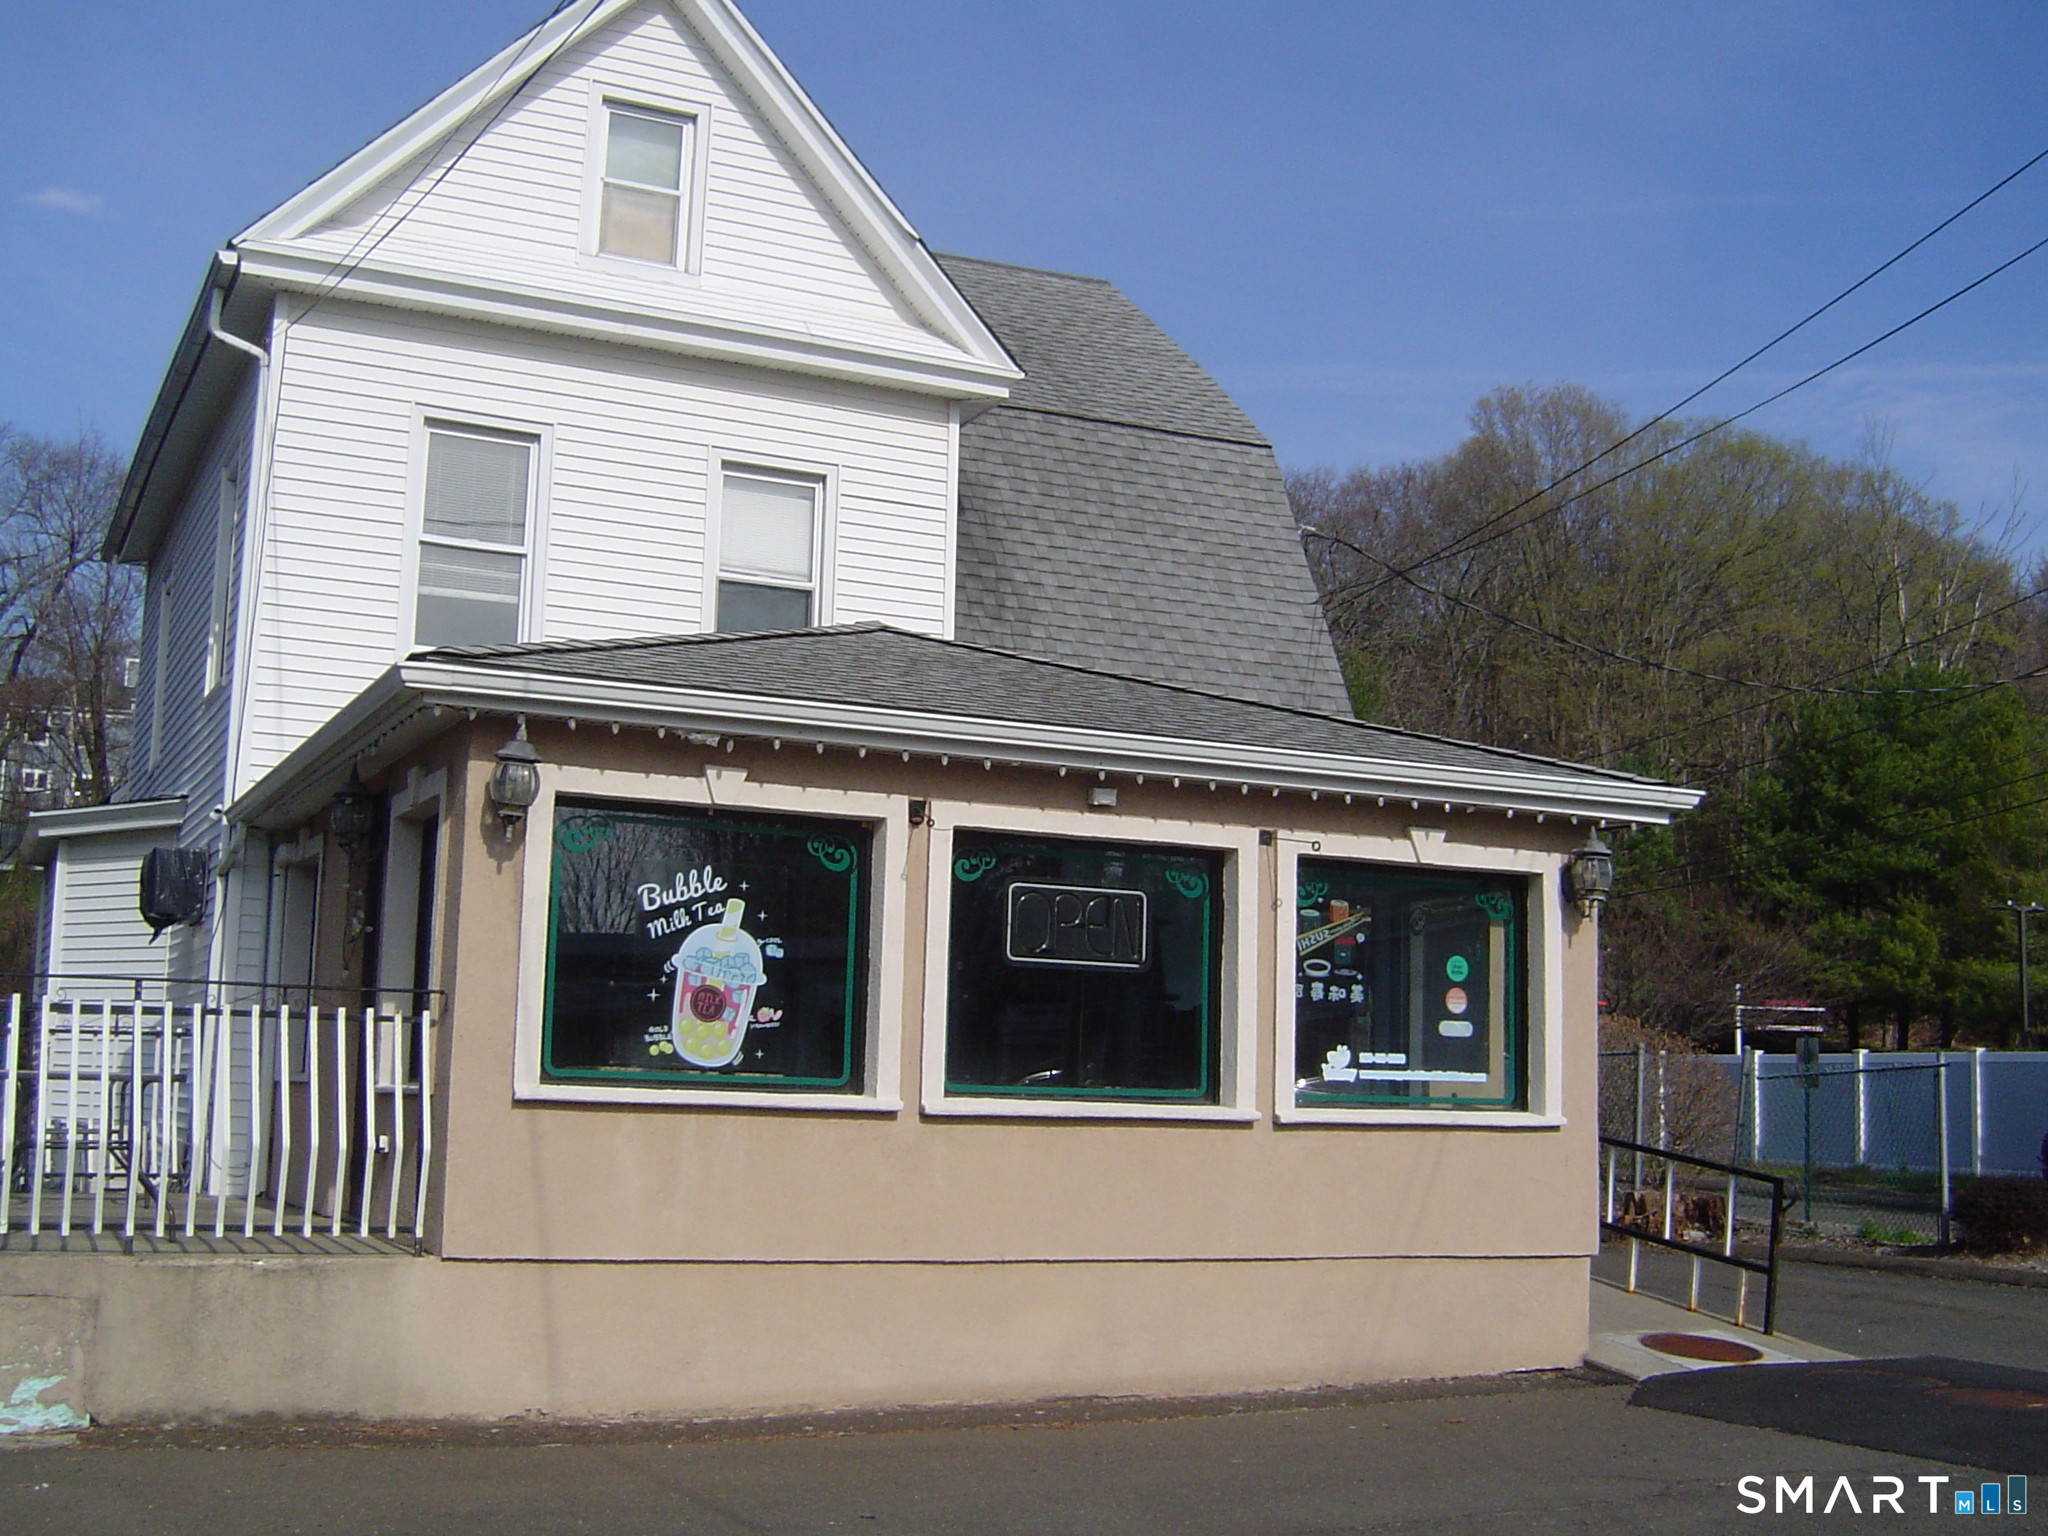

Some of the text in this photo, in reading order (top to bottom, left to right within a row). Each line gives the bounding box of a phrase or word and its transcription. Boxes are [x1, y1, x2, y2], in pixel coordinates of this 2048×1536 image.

[637, 864, 728, 911] Bubble
[646, 900, 726, 939] Milk Tea
[1015, 891, 1141, 960] OPEN
